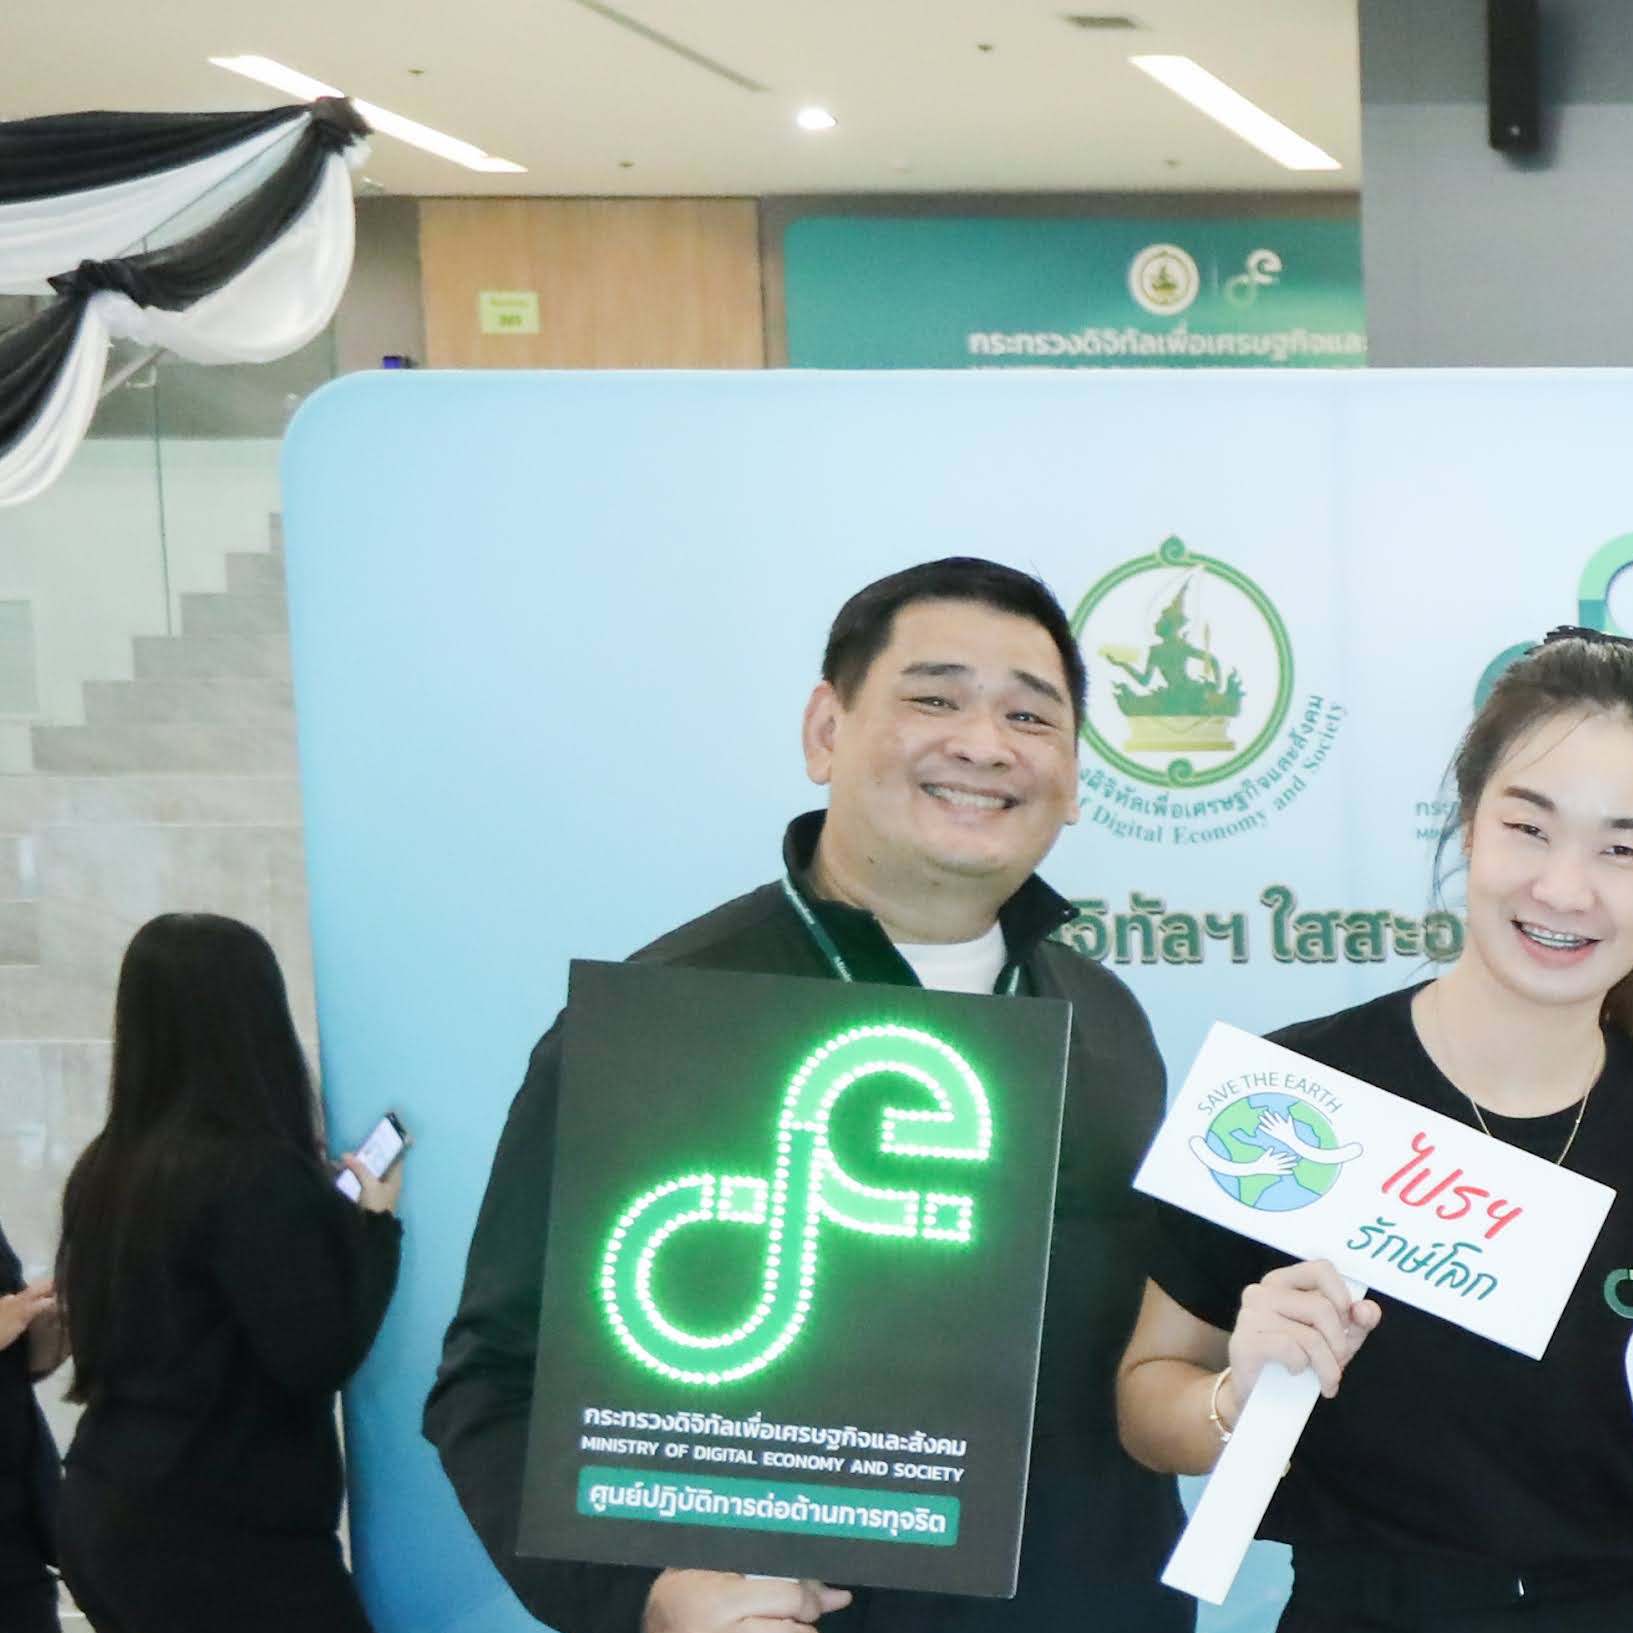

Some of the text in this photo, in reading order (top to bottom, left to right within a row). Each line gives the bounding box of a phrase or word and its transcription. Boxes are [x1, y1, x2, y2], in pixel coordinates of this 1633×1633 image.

[1091, 702, 1348, 845] Digital Economy and Society
[1198, 1071, 1344, 1116] SAVE THE EARTH
[1346, 1216, 1498, 1301] รักษ์โลก
[583, 1407, 967, 1457] กระทรวงดิจิทัลเพื่อเศรษฐกิจและสังคม
[580, 1436, 965, 1483] MINISTRY OF DIGITAL ECONOMY AND SOCIETY
[589, 1481, 948, 1537] ศูนย์ปฏิบัติการต่อต้านการทุจริต
